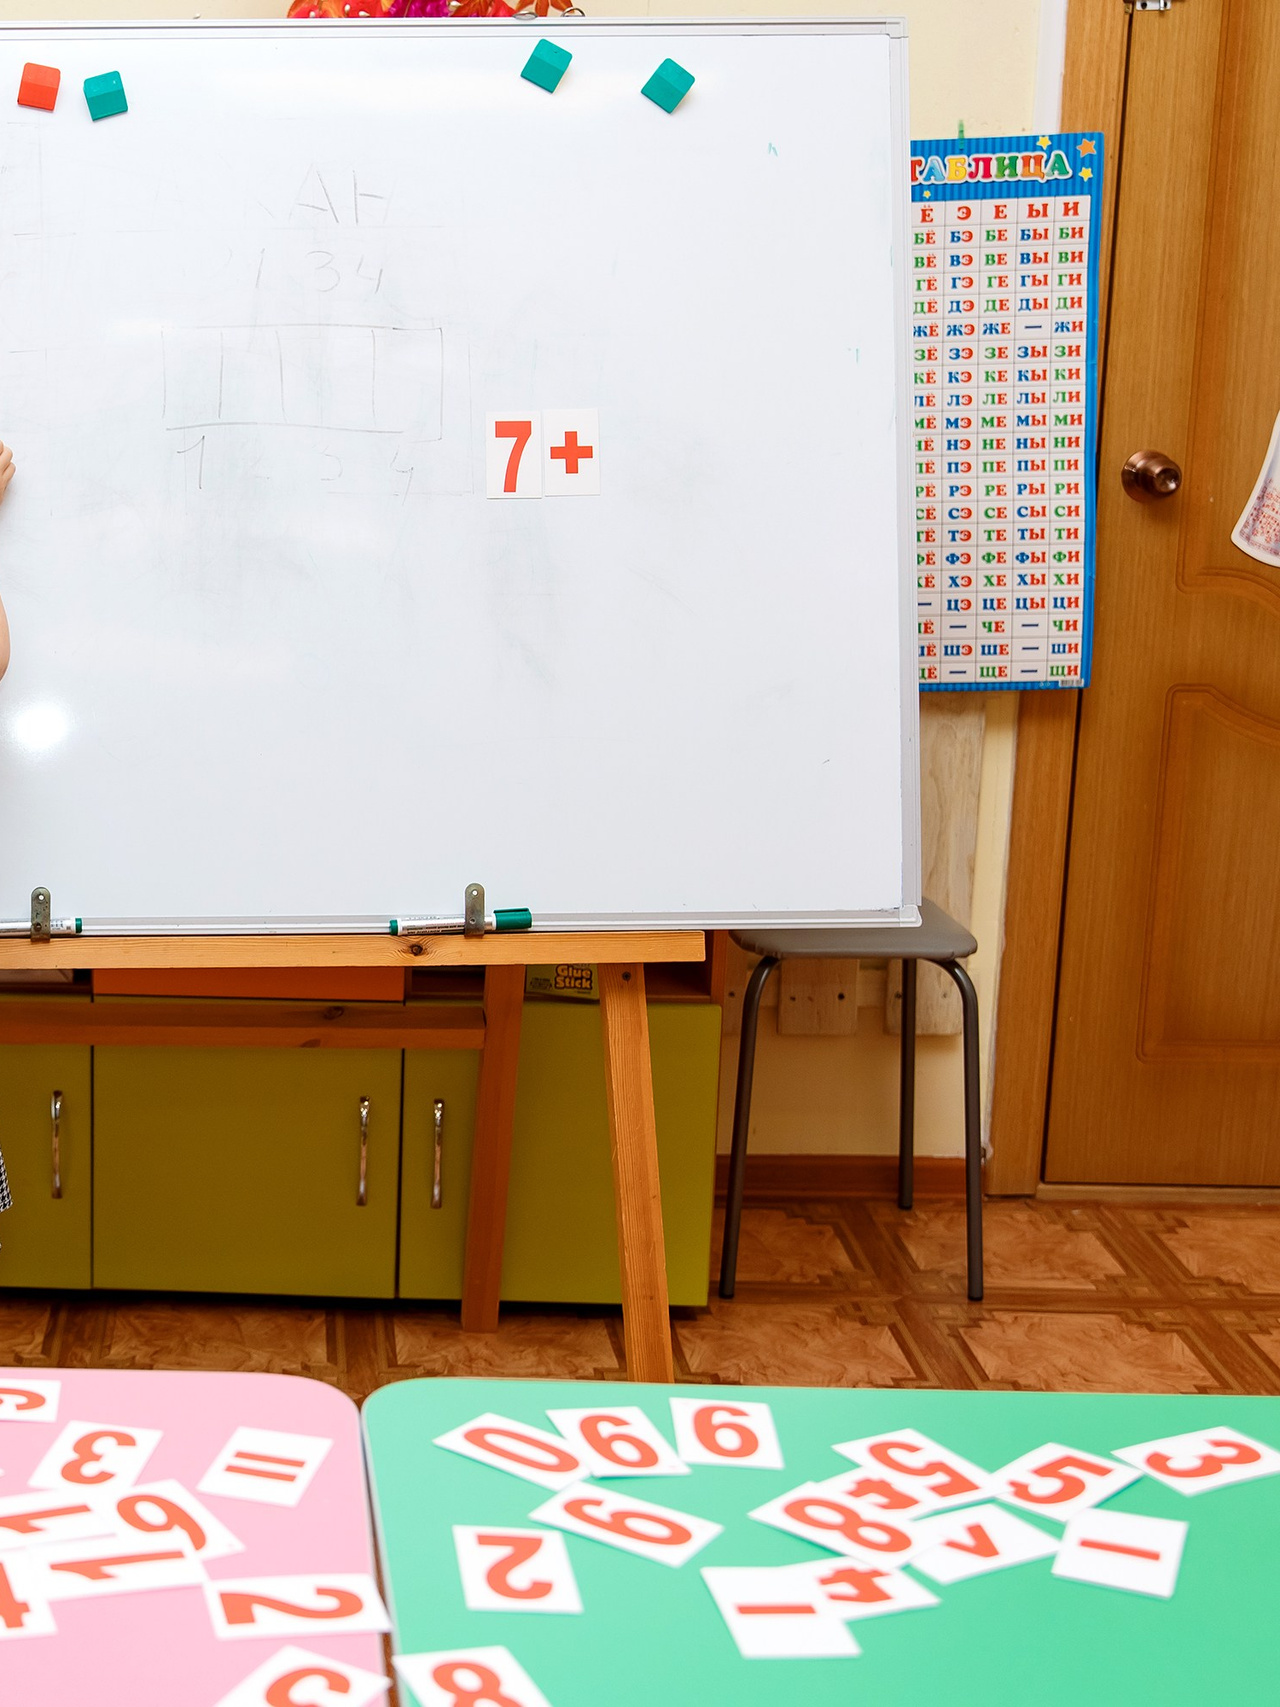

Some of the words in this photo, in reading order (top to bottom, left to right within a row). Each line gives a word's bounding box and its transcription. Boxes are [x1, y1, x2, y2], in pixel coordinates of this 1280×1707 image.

[910, 152, 1071, 182] ТАБЛИЦА
[915, 230, 935, 244] БЁ
[951, 231, 973, 242] БЭ
[986, 229, 1007, 241] БЕ
[1021, 228, 1048, 241] БЫ
[1060, 227, 1083, 239] БИ
[915, 254, 936, 267] ВЁ
[950, 255, 973, 266] ВЭ
[986, 254, 1007, 265] ВЕ
[1020, 252, 1048, 264] ВЫ
[1059, 251, 1083, 263] ВИ
[917, 276, 937, 290] ГЁ
[952, 277, 973, 289] ГЭ
[988, 276, 1008, 287] ГЕ
[1021, 274, 1048, 286] ГЫ
[1058, 273, 1082, 285] ГИ
[914, 300, 937, 314] ДЁ
[949, 300, 974, 313] ДЭ
[985, 299, 1009, 312] ДЕ
[1019, 298, 1048, 311] ДЫ
[1056, 297, 1082, 309] ДИ
[947, 324, 975, 336] ЖЭ
[983, 323, 1010, 335] ЖЕ
[1055, 321, 1083, 332] ЖИ
[915, 346, 937, 360] ЗЁ
[949, 348, 973, 360] ЗЭ
[985, 347, 1008, 358] ЗЕ
[1018, 346, 1047, 358] ЗЫ
[1055, 345, 1081, 357] ЗИ
[914, 370, 936, 383] КЁ
[948, 371, 972, 383] КЭ
[985, 371, 1007, 382] КЕ
[1018, 369, 1047, 381] КЫ
[1055, 368, 1080, 380] КИ
[947, 395, 972, 406] ЛЭ
[983, 393, 1007, 404] ЛЕ
[1017, 392, 1046, 404] ЛЫ
[1054, 391, 1080, 402] ЛИ
[946, 417, 972, 429] МЭ
[982, 416, 1006, 427] МЕ
[1017, 415, 1046, 426] МЫ
[1055, 414, 1082, 425] МИ
[947, 439, 971, 450] НЭ
[983, 438, 1006, 449] НЕ
[1017, 437, 1045, 449] НЫ
[1054, 436, 1080, 448] НИ
[495, 421, 532, 492] 7
[948, 462, 972, 473] ПЭ
[983, 461, 1006, 472] ПЕ
[1018, 460, 1045, 471] ПЫ
[1055, 459, 1078, 470] ПИ
[915, 484, 936, 497] РЁ
[949, 485, 972, 496] РЭ
[986, 485, 1007, 496] РЕ
[1018, 483, 1045, 495] РЫ
[1056, 483, 1079, 494] РИ
[948, 508, 972, 519] СЭ
[984, 507, 1007, 518] СЕ
[1017, 506, 1046, 517] СЫ
[1055, 505, 1079, 517] СИ
[948, 530, 972, 542] ТЭ
[984, 529, 1006, 541] ТЕ
[1018, 528, 1045, 540] ТЫ
[1055, 528, 1079, 539] ТИ
[946, 553, 971, 564] ФЭ
[982, 552, 1006, 563] ФЕ
[1015, 552, 1046, 563] ФЫ
[1053, 551, 1080, 562] ФИ
[949, 576, 972, 587] ХЭ
[984, 575, 1006, 586] ХЕ
[1018, 574, 1046, 585] ХЫ
[1055, 573, 1079, 585] ХИ
[947, 599, 972, 612] ЦЭ
[983, 598, 1006, 611] ЦЕ
[1016, 597, 1045, 610] ЦЫ
[1053, 597, 1079, 609] ЦИ
[982, 621, 1005, 633] ЧЕ
[1053, 620, 1078, 631] ЧИ
[944, 645, 973, 656] ШЭ
[981, 644, 1009, 655] ШЕ
[1052, 643, 1079, 654] ШИ
[556, 964, 592, 978] Glue
[555, 976, 592, 990] Stick
[60, 1431, 136, 1485] 3
[1146, 1440, 1262, 1478] 3
[868, 1441, 980, 1498] 5
[1009, 1455, 1113, 1504] 5
[783, 1498, 912, 1553] 8
[477, 1534, 553, 1600] 2
[219, 1586, 363, 1625] 2
